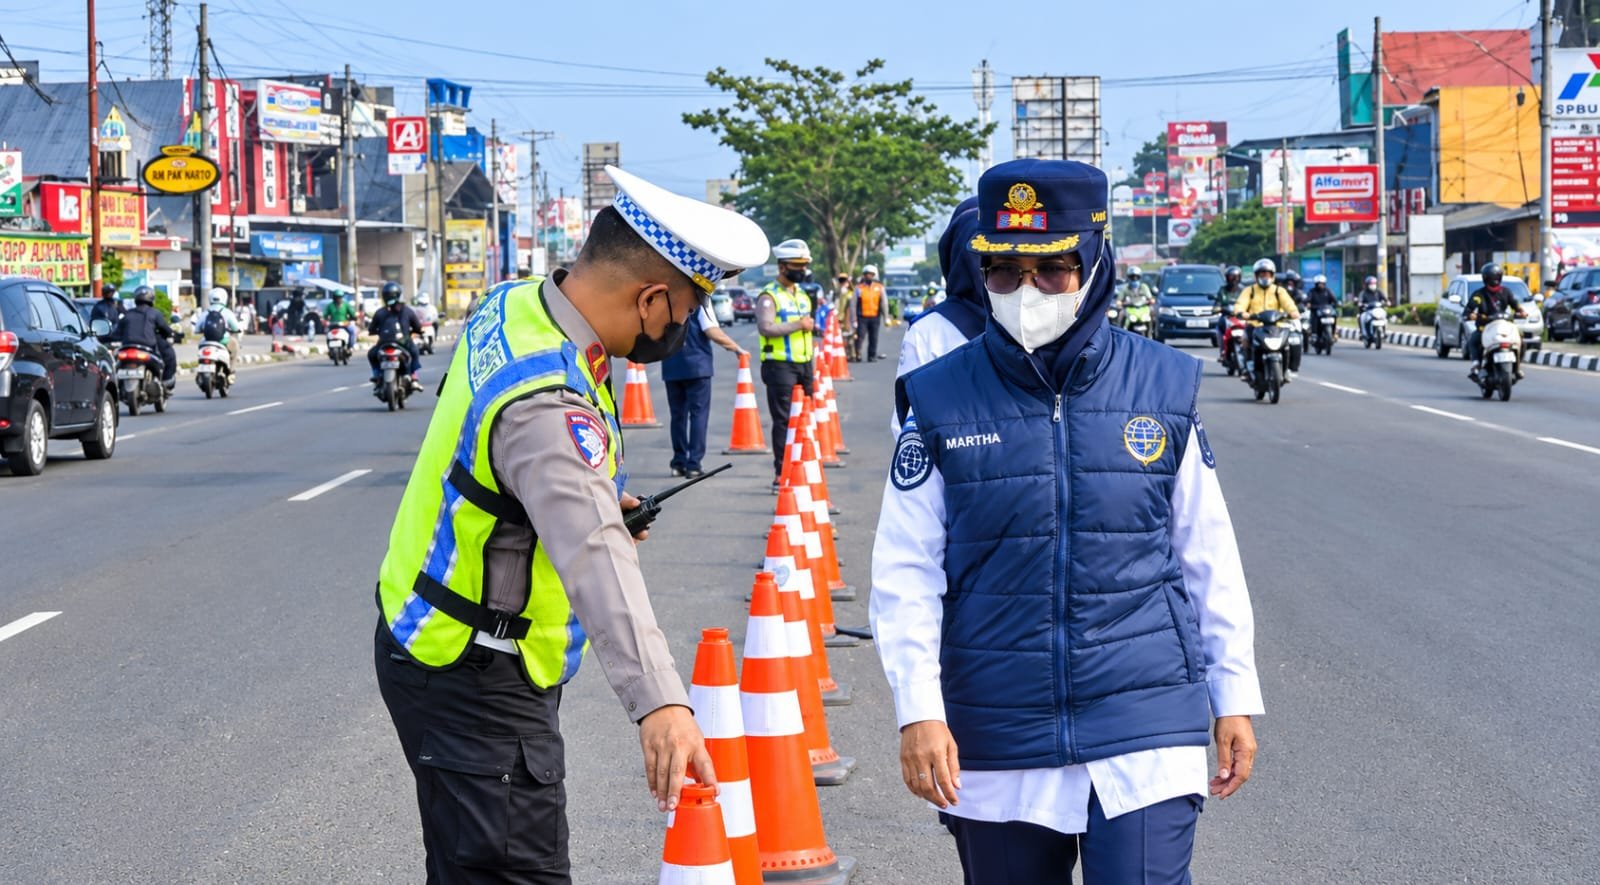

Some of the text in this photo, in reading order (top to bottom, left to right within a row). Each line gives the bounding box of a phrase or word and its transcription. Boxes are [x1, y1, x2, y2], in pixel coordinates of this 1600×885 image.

[1555, 104, 1598, 115] SPBU
[152, 170, 211, 180] RM PAK NARTO
[945, 432, 1001, 450] MARTHA
